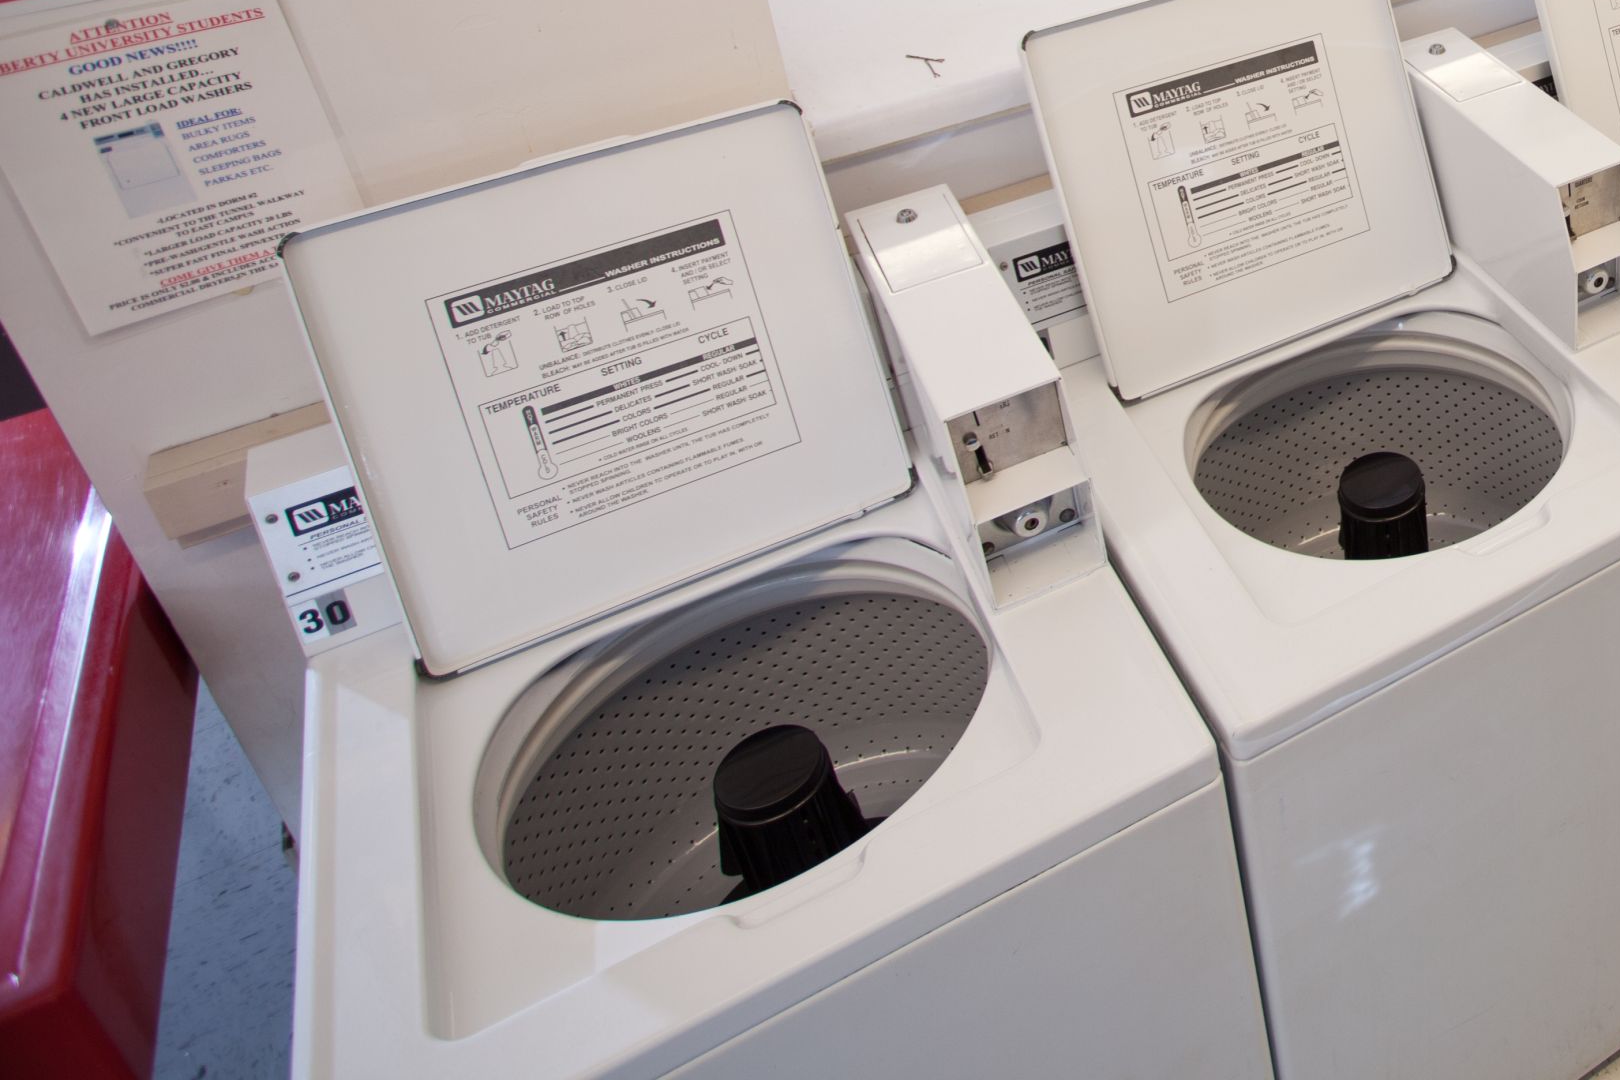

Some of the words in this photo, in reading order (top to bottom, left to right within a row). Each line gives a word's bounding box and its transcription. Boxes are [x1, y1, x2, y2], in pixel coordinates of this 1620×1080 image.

[64, 26, 177, 60] UNIVERSITY
[175, 7, 265, 36] STUDENTS
[69, 12, 173, 43] ATTENTION
[68, 56, 122, 75] GOOD
[125, 38, 198, 60] NEWS!!!!
[38, 73, 128, 100] CALDWELL
[133, 64, 163, 78] AND
[166, 47, 238, 70] GREGORY
[1234, 70, 1265, 83] WASHER
[1265, 55, 1314, 74] INSTRUCTIONS
[60, 112, 68, 120] 4
[71, 103, 106, 116] NEW
[111, 89, 164, 109] LARGE
[166, 71, 240, 95] CAPACITY
[79, 89, 112, 103] HAS
[114, 69, 213, 95] INSTALLED...
[1152, 81, 1200, 103] MAYTAG
[80, 109, 131, 129] FRONT
[135, 99, 178, 116] LOAD
[180, 81, 252, 104] WASHERS
[176, 114, 214, 129] IDEAL
[213, 107, 243, 121] FOR:
[181, 124, 219, 140] BULKY
[222, 116, 256, 130] ITEMS
[188, 139, 218, 151] AREA
[219, 130, 250, 143] RUGS
[1297, 130, 1320, 143] CYCLE
[192, 139, 266, 163] COMFORTERS
[198, 156, 251, 175] SLEEPING
[251, 148, 282, 161] BAGS
[1230, 150, 1260, 165] SETTING
[204, 170, 248, 187] PARKAS
[249, 164, 273, 175] ETC.
[1151, 168, 1204, 190] TEMPERATURE
[604, 259, 648, 277] WASHER
[649, 237, 720, 264] INSTRUCTIONS
[1173, 260, 1204, 275] PERSONAL
[614, 279, 637, 291] CLOSE
[636, 276, 647, 284] LID
[1179, 268, 1201, 280] SAFETY
[485, 278, 554, 308] MAYTAG
[464, 328, 479, 338] ADD
[479, 315, 520, 333] DETERGENT
[476, 332, 492, 341] TUB
[697, 327, 729, 344] CYCLE
[600, 356, 642, 376] SETTING
[595, 387, 638, 407] PERMANENT
[639, 379, 663, 392] PRESS
[712, 374, 744, 390] REGULAR
[484, 383, 561, 414] TEMPERATURE
[614, 394, 652, 412] DELICATES
[621, 406, 652, 421] COLORS
[625, 426, 662, 443] WOOLENS
[516, 494, 562, 515] PERSONAL
[526, 504, 558, 520] SAFETY
[530, 512, 559, 527] RULES
[299, 599, 351, 635] 30
